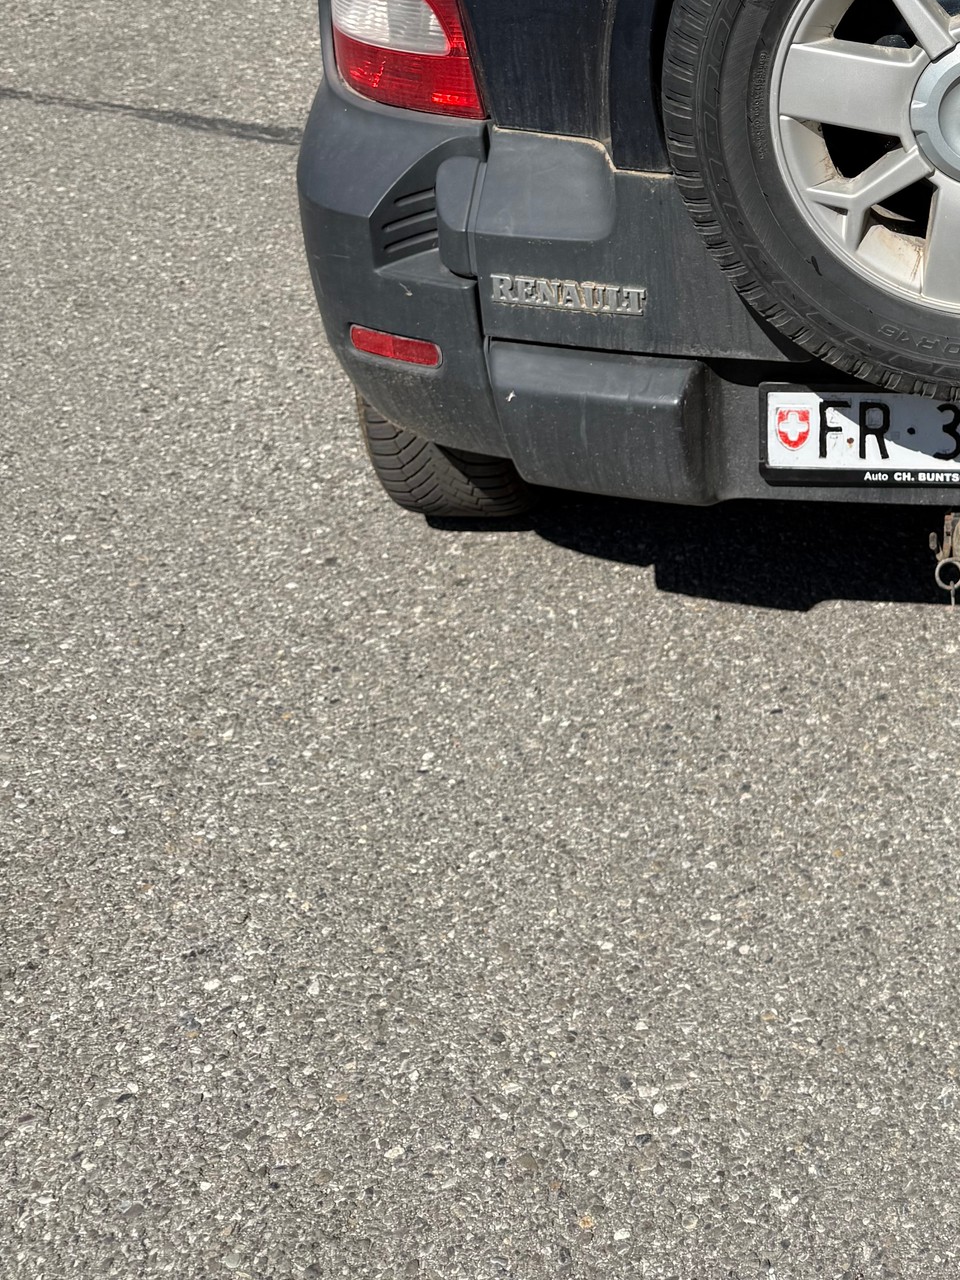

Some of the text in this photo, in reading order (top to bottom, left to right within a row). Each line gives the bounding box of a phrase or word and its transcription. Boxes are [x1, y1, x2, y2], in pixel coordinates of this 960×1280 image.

[490, 274, 648, 316] RENAULT
[863, 471, 889, 481] Auto
[893, 472, 915, 481] CH.
